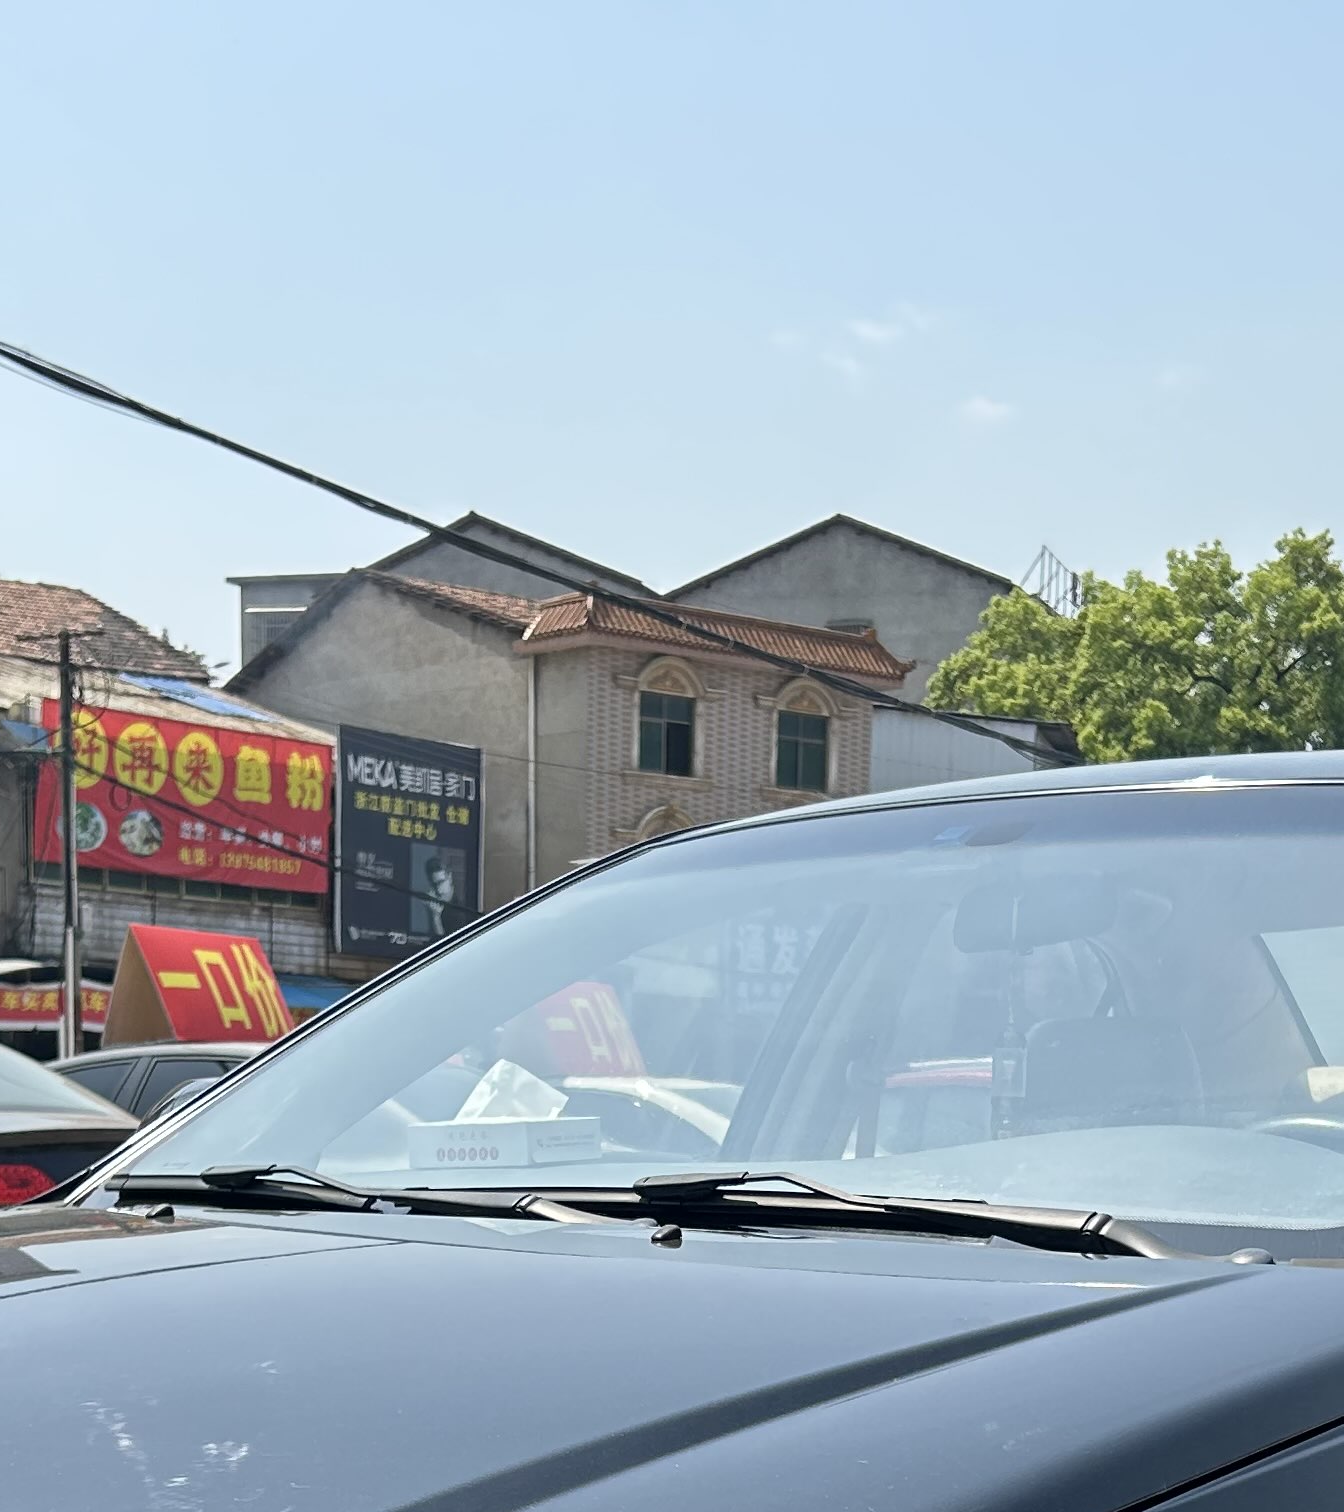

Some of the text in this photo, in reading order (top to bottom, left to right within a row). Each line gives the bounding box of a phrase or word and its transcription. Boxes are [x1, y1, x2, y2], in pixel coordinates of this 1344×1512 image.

[347, 752, 398, 790] MEKA
[159, 943, 293, 1039] 一口价
